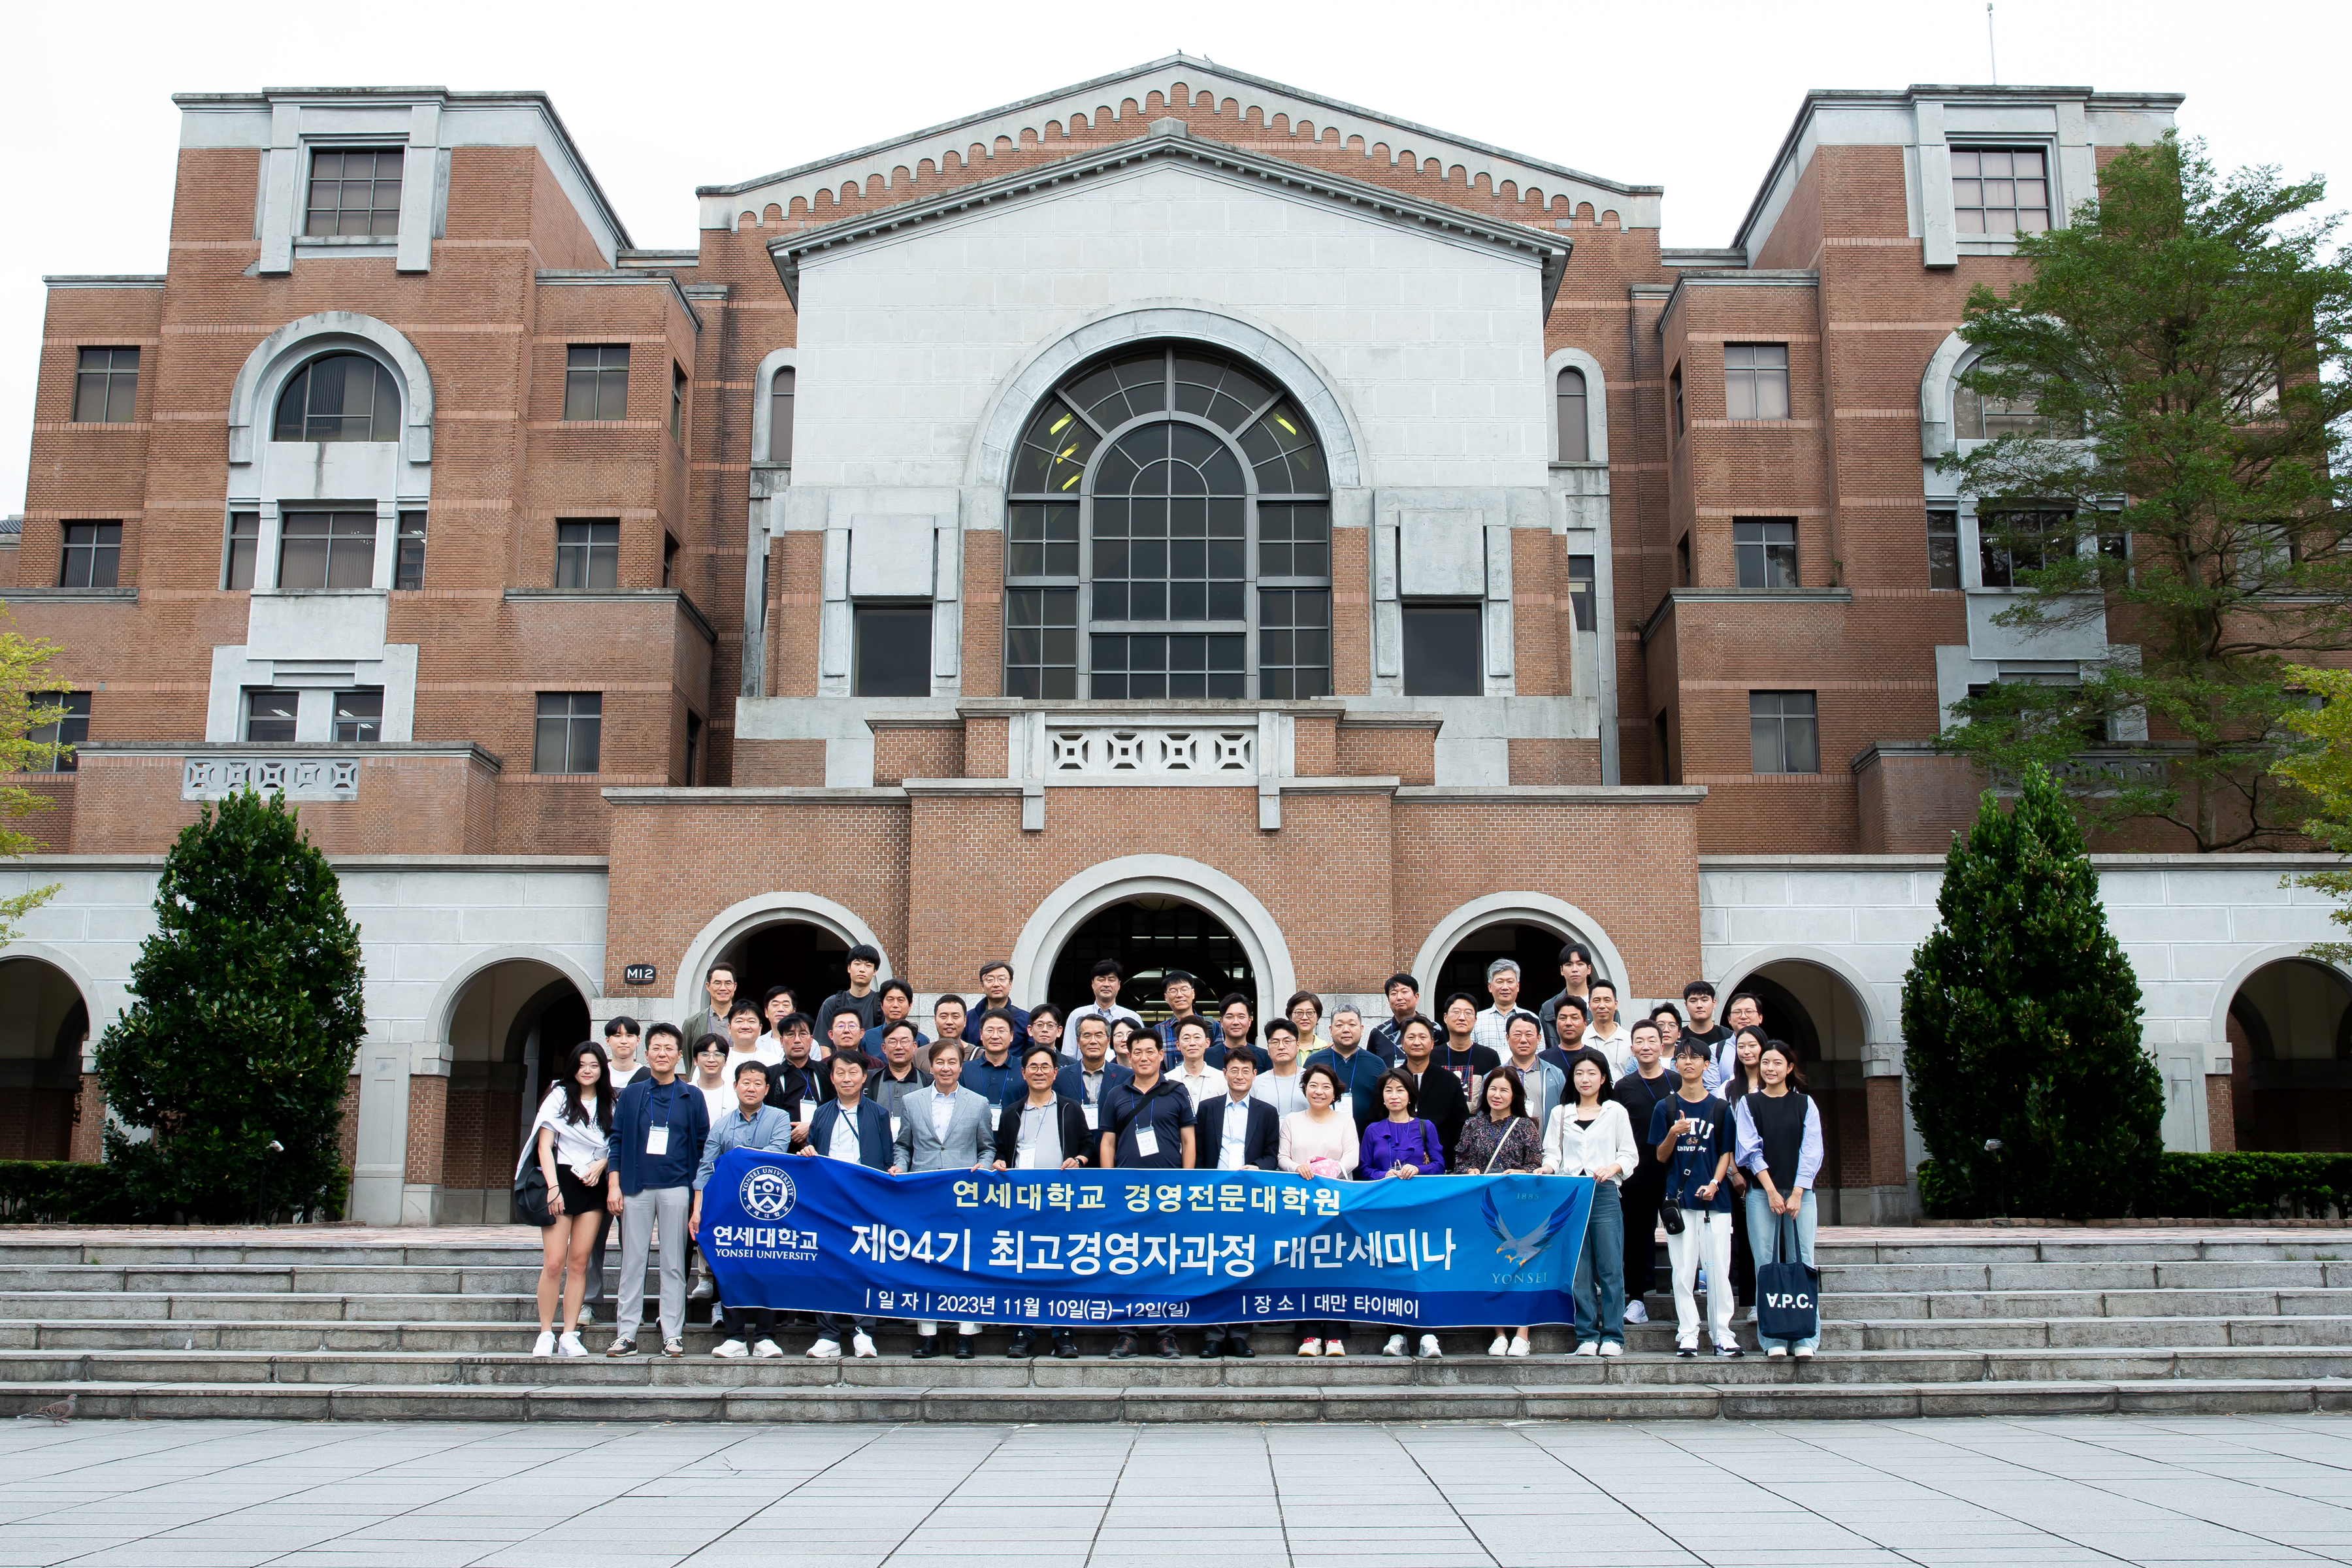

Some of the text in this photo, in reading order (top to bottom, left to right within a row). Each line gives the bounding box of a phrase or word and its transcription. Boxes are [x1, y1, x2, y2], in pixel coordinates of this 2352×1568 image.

[1674, 1117, 1714, 1139] TU
[742, 1168, 794, 1196] YONSEI UNIVERSITY
[953, 1181, 1341, 1216] 연세대학교 경영전문대학원
[713, 1226, 818, 1250] 연세대학교
[715, 1248, 818, 1262] YONSEI UNIVERSITY
[849, 1224, 1456, 1277] 제94기 최고경영자과정 대만세미나
[1491, 1271, 1548, 1284] YONSEI
[937, 1295, 995, 1315] 2023년
[1004, 1298, 1039, 1317] 11월
[1314, 1294, 1347, 1313] 대만
[1354, 1295, 1418, 1319] 타이베이
